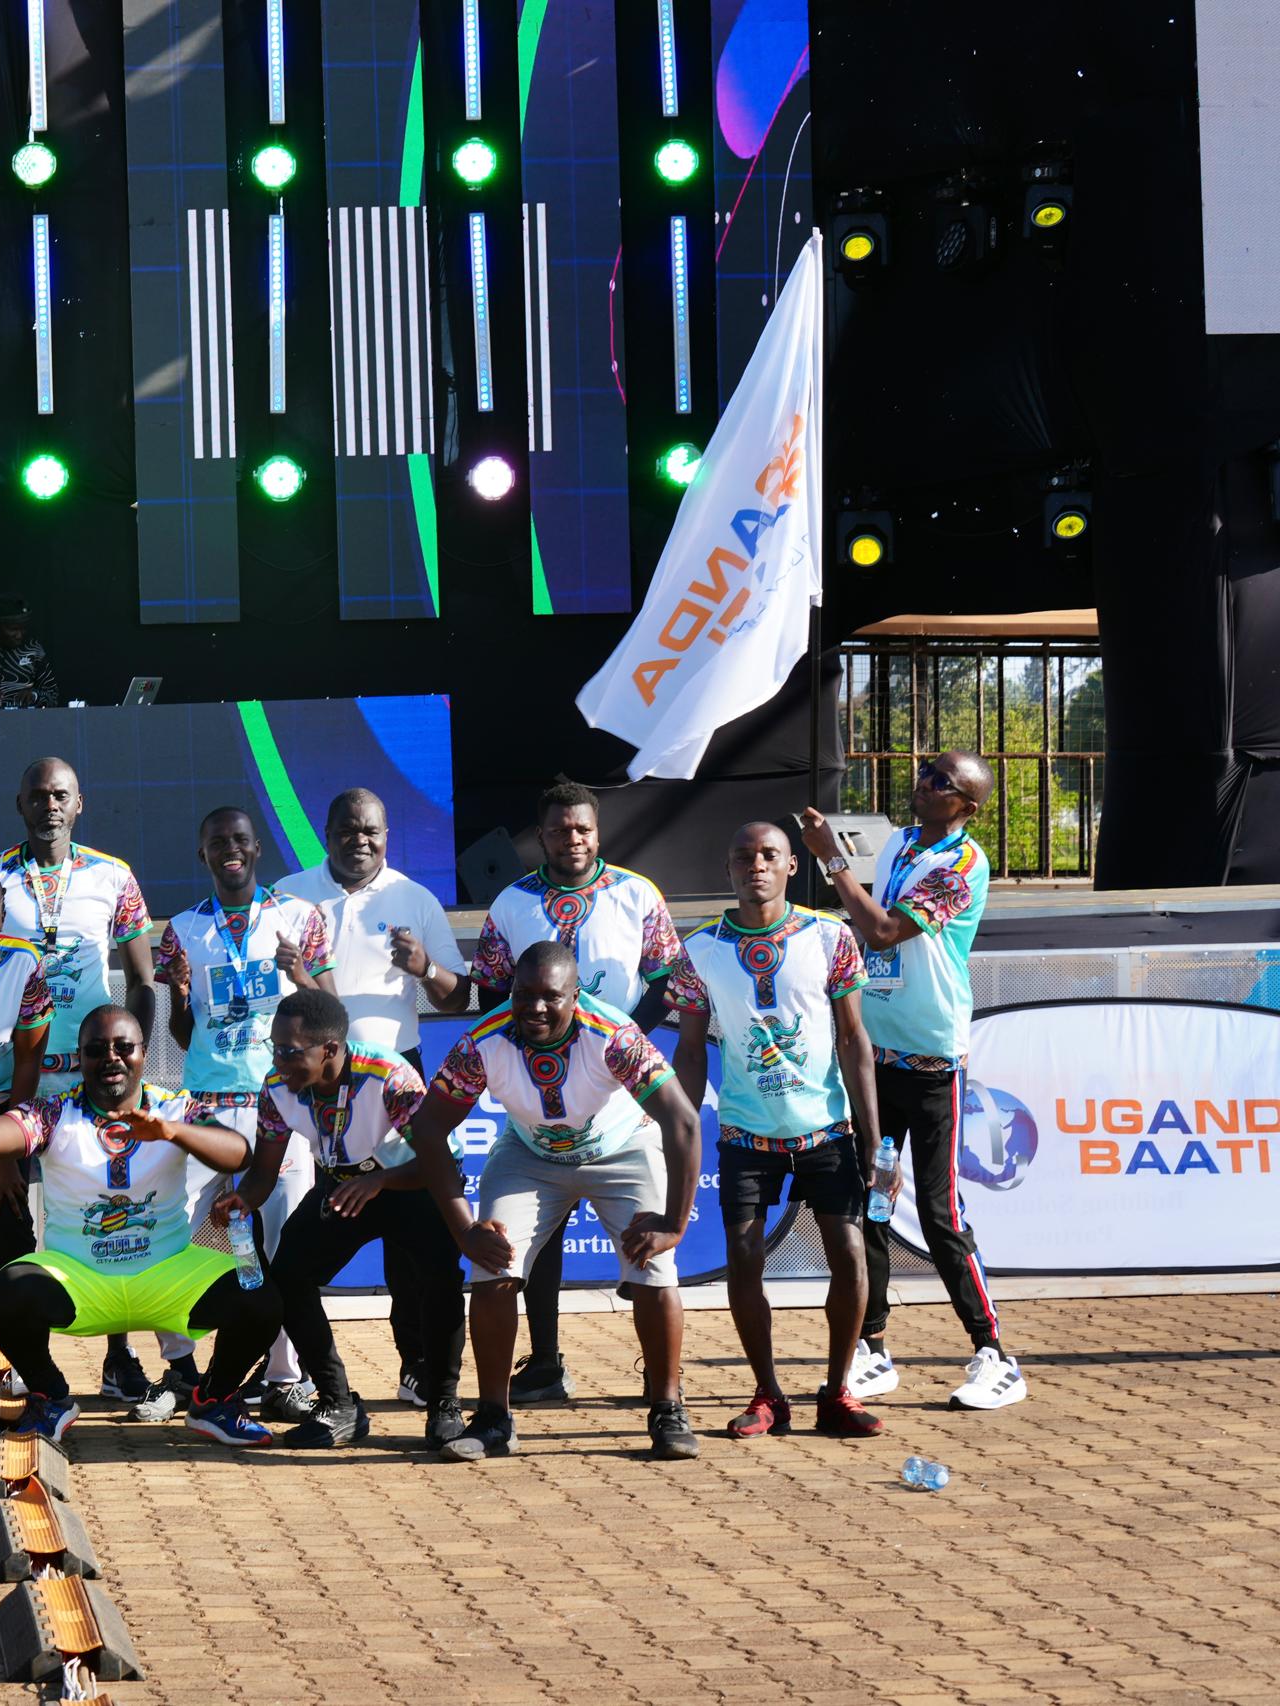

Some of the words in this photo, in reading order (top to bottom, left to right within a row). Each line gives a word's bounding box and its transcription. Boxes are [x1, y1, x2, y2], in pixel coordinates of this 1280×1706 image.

[226, 977, 266, 1003] 115
[757, 1072, 805, 1092] GULU
[1079, 1139, 1271, 1175] BAATI
[91, 1237, 150, 1258] GULU
[114, 1251, 151, 1263] MARATHON
